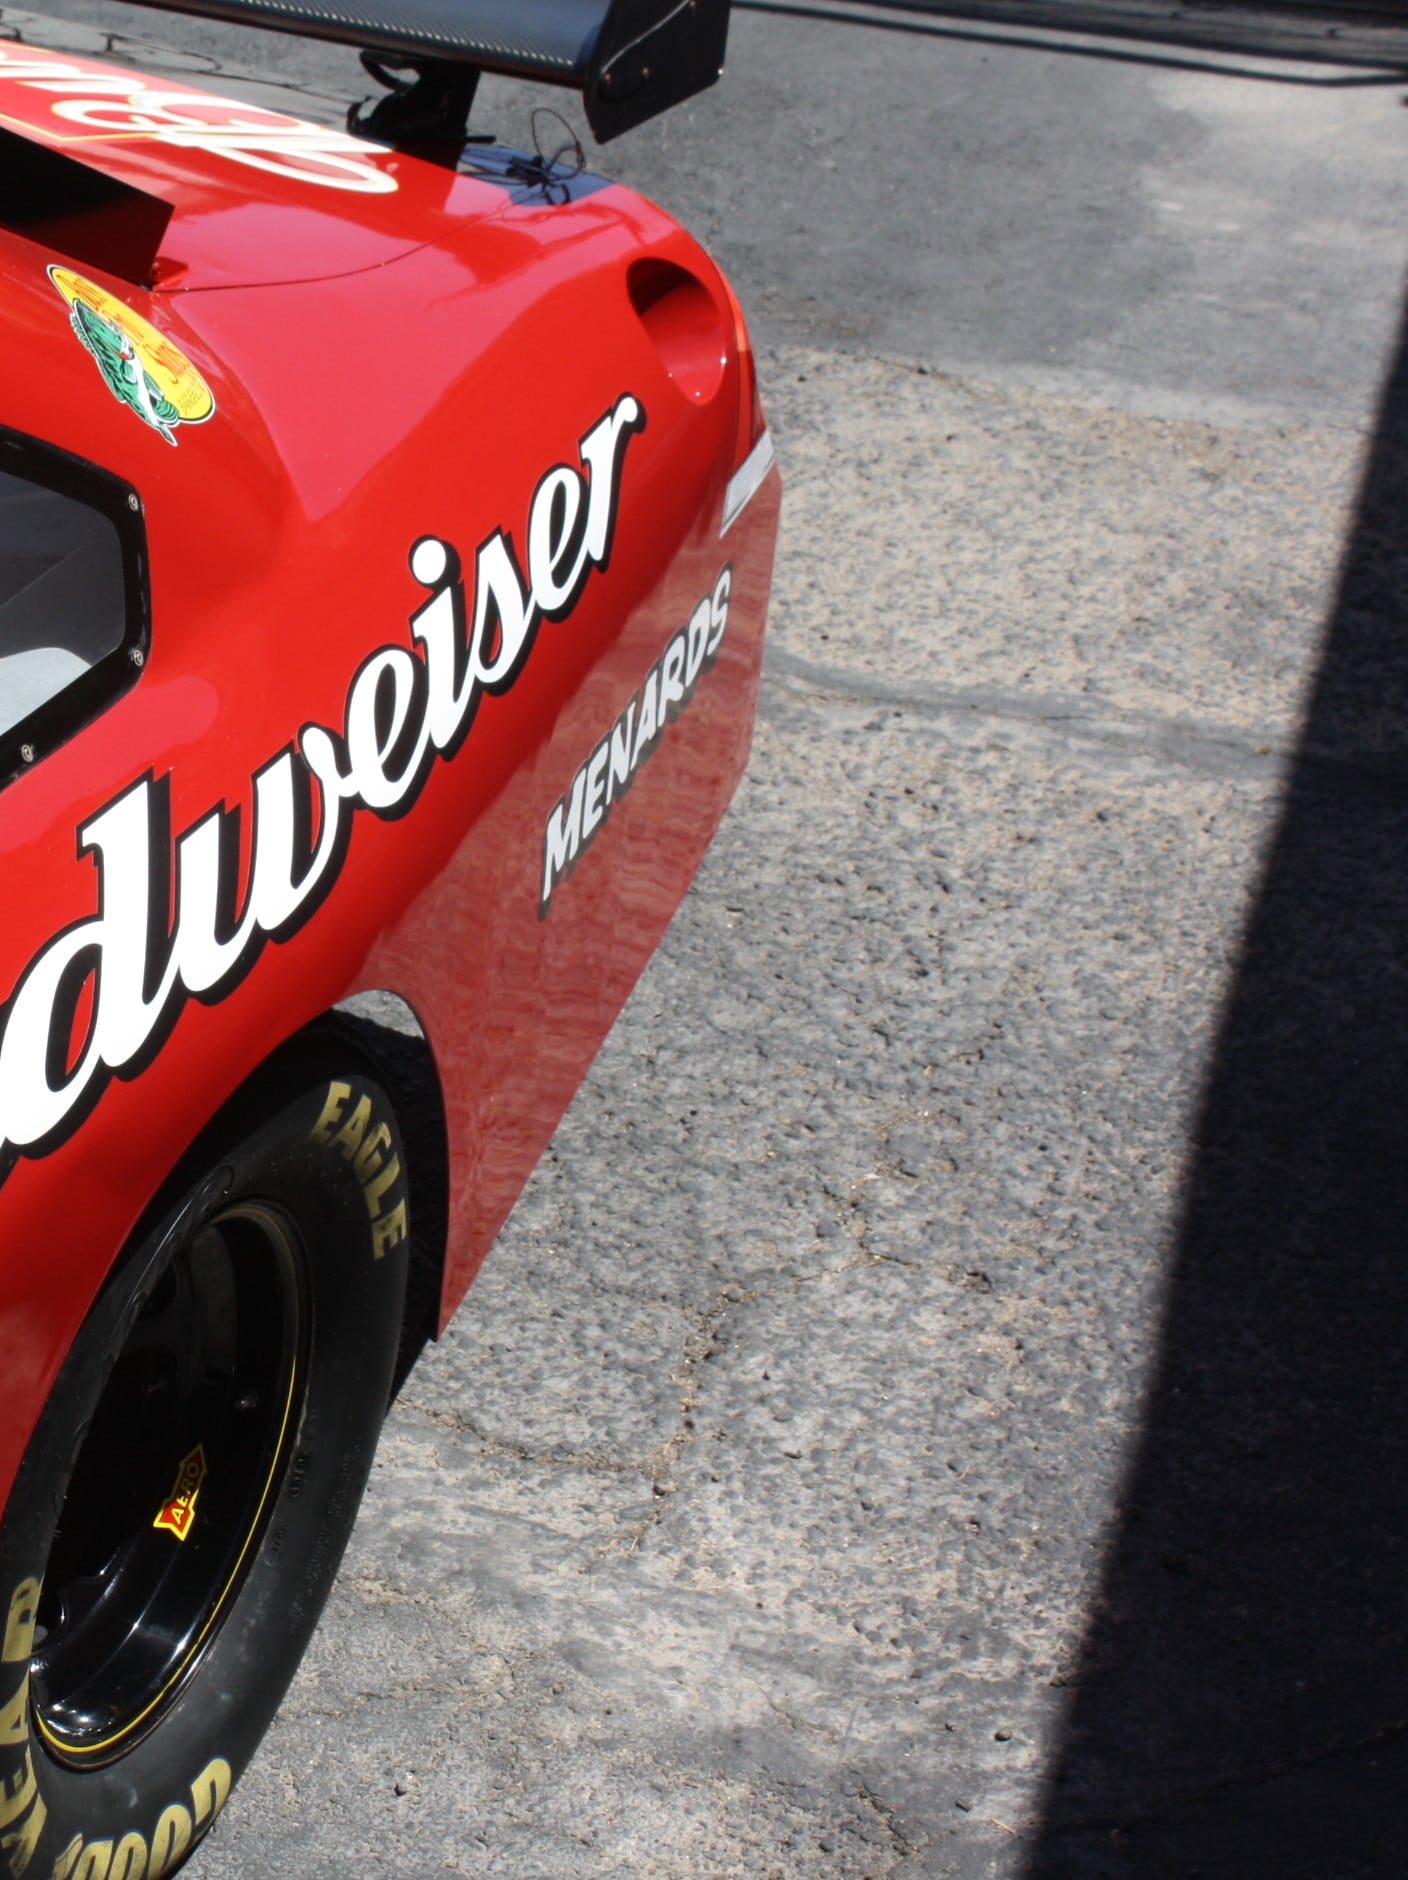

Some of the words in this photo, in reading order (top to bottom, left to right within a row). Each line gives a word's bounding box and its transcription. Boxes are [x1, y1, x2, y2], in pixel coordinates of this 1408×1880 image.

[542, 566, 732, 905] MENARDS
[306, 1080, 408, 1261] EAGLE
[171, 1462, 200, 1526] AERO
